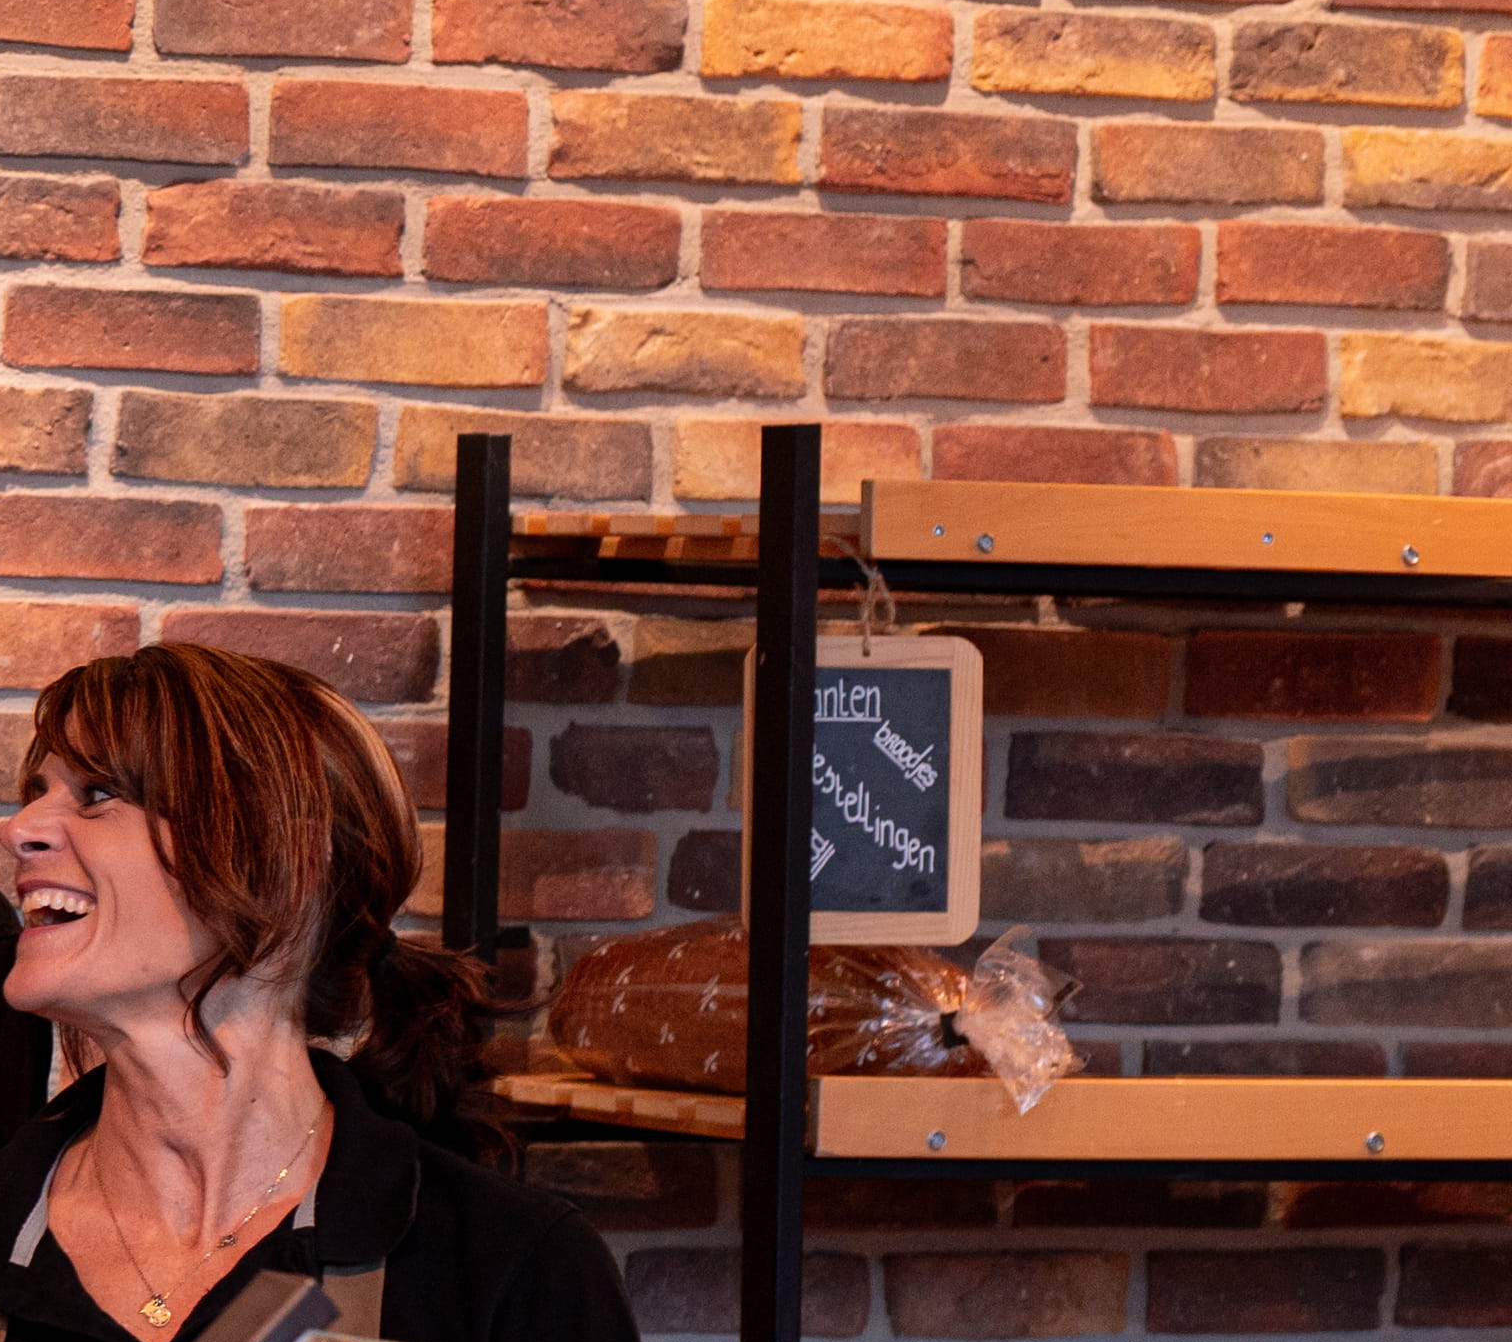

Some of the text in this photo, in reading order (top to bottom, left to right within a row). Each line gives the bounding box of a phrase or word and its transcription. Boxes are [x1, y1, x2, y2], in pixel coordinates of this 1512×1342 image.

[815, 678, 882, 719] anten
[874, 720, 938, 788] broodjes
[813, 743, 935, 873] estellingen
